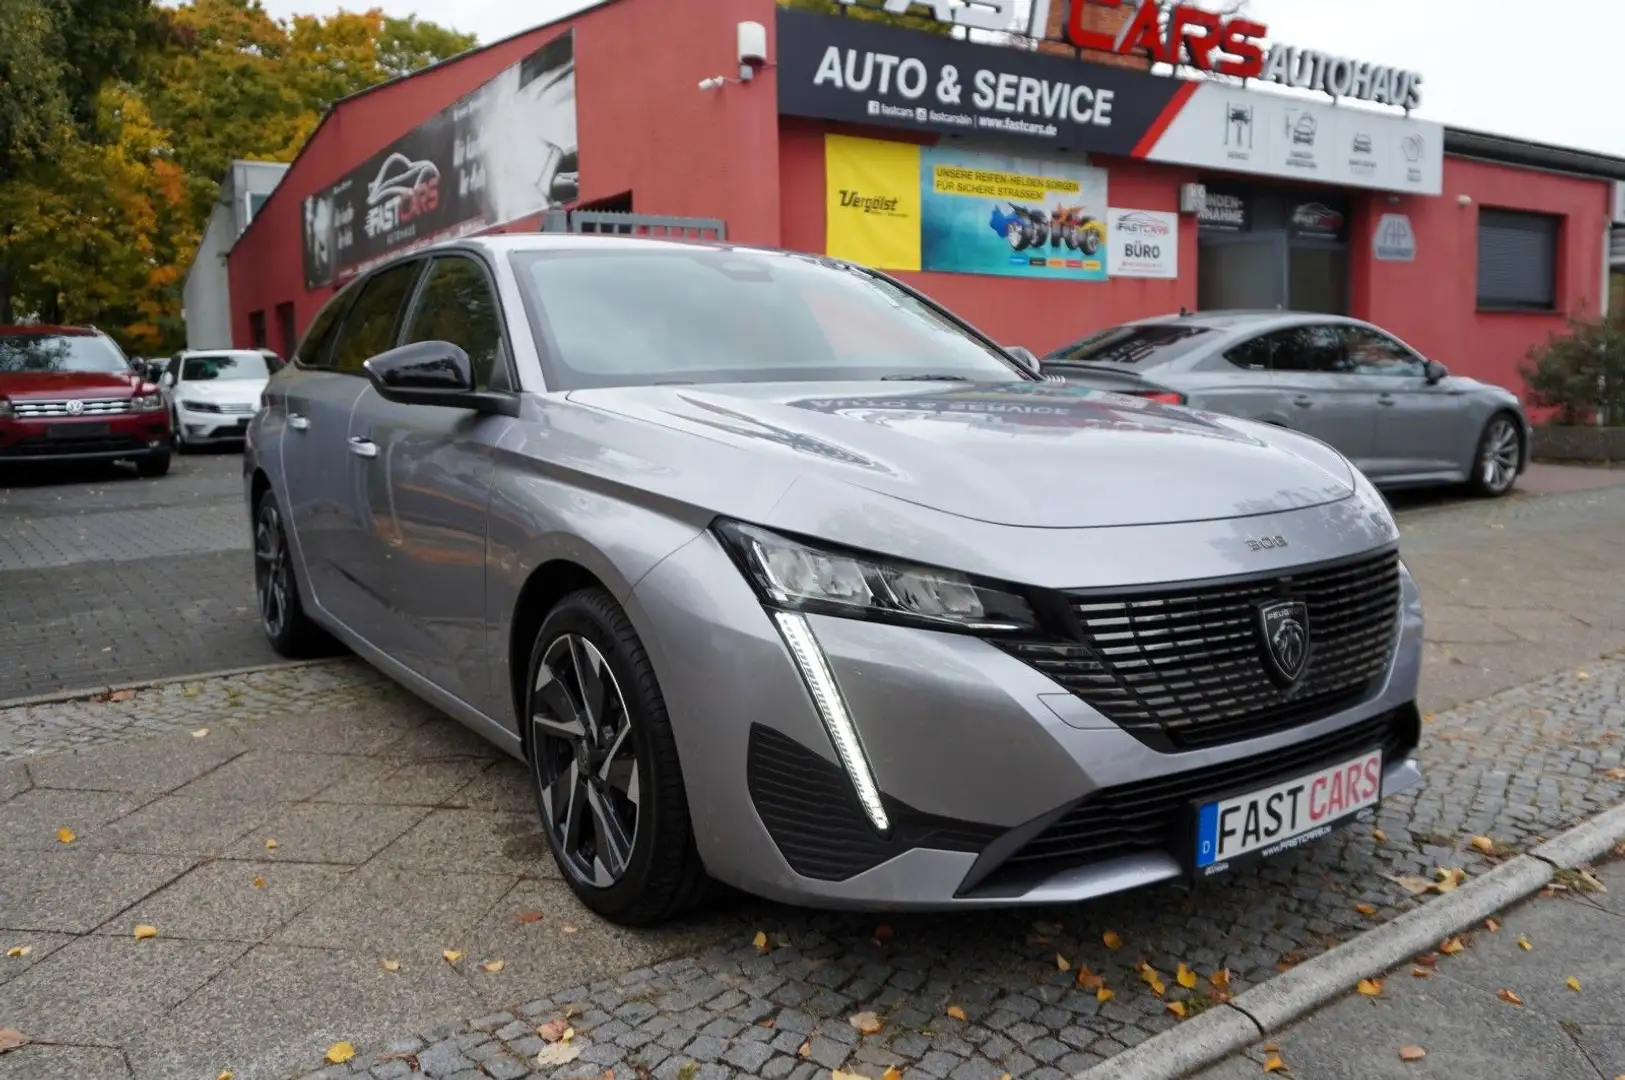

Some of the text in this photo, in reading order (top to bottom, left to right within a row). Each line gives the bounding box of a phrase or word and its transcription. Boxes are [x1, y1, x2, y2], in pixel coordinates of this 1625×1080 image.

[813, 46, 1115, 125] AUTO & SERVICE
[1262, 43, 1423, 109] AUTOHAUS
[881, 103, 914, 118] fastcars
[979, 116, 1057, 136] www.fastcars.de
[936, 168, 973, 180] UNSERE
[1046, 179, 1080, 192] SORGEN
[957, 183, 995, 196] SICHERE
[1123, 239, 1161, 259] BÜRO
[1244, 535, 1288, 552] 308
[1202, 840, 1210, 855] D
